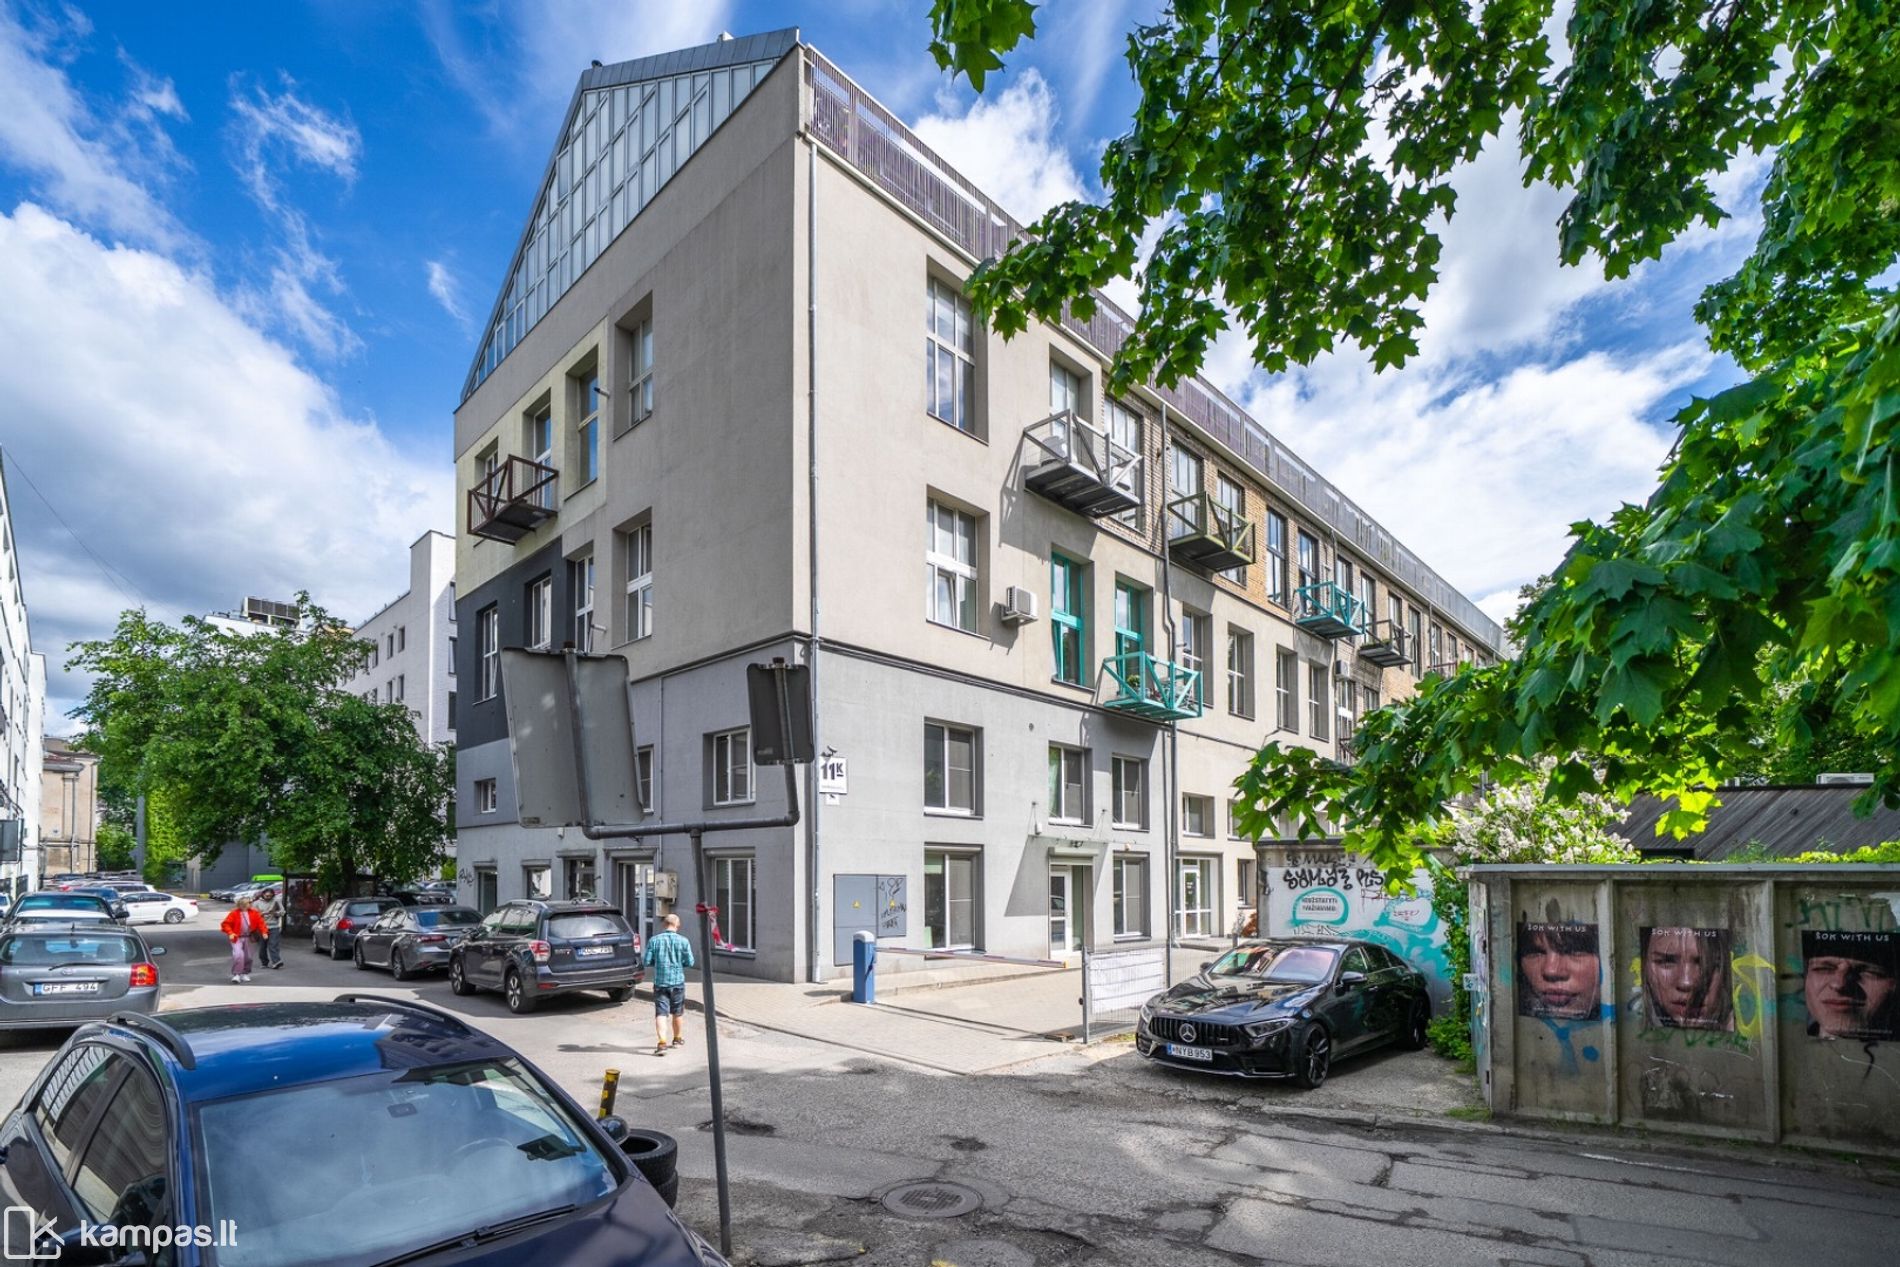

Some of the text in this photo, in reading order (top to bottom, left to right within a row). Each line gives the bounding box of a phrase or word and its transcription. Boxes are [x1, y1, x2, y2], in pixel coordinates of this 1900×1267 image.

[1575, 925, 1586, 933] US
[1674, 929, 1700, 937] WITH
[1840, 933, 1872, 942] WITH
[1875, 934, 1890, 942] US
